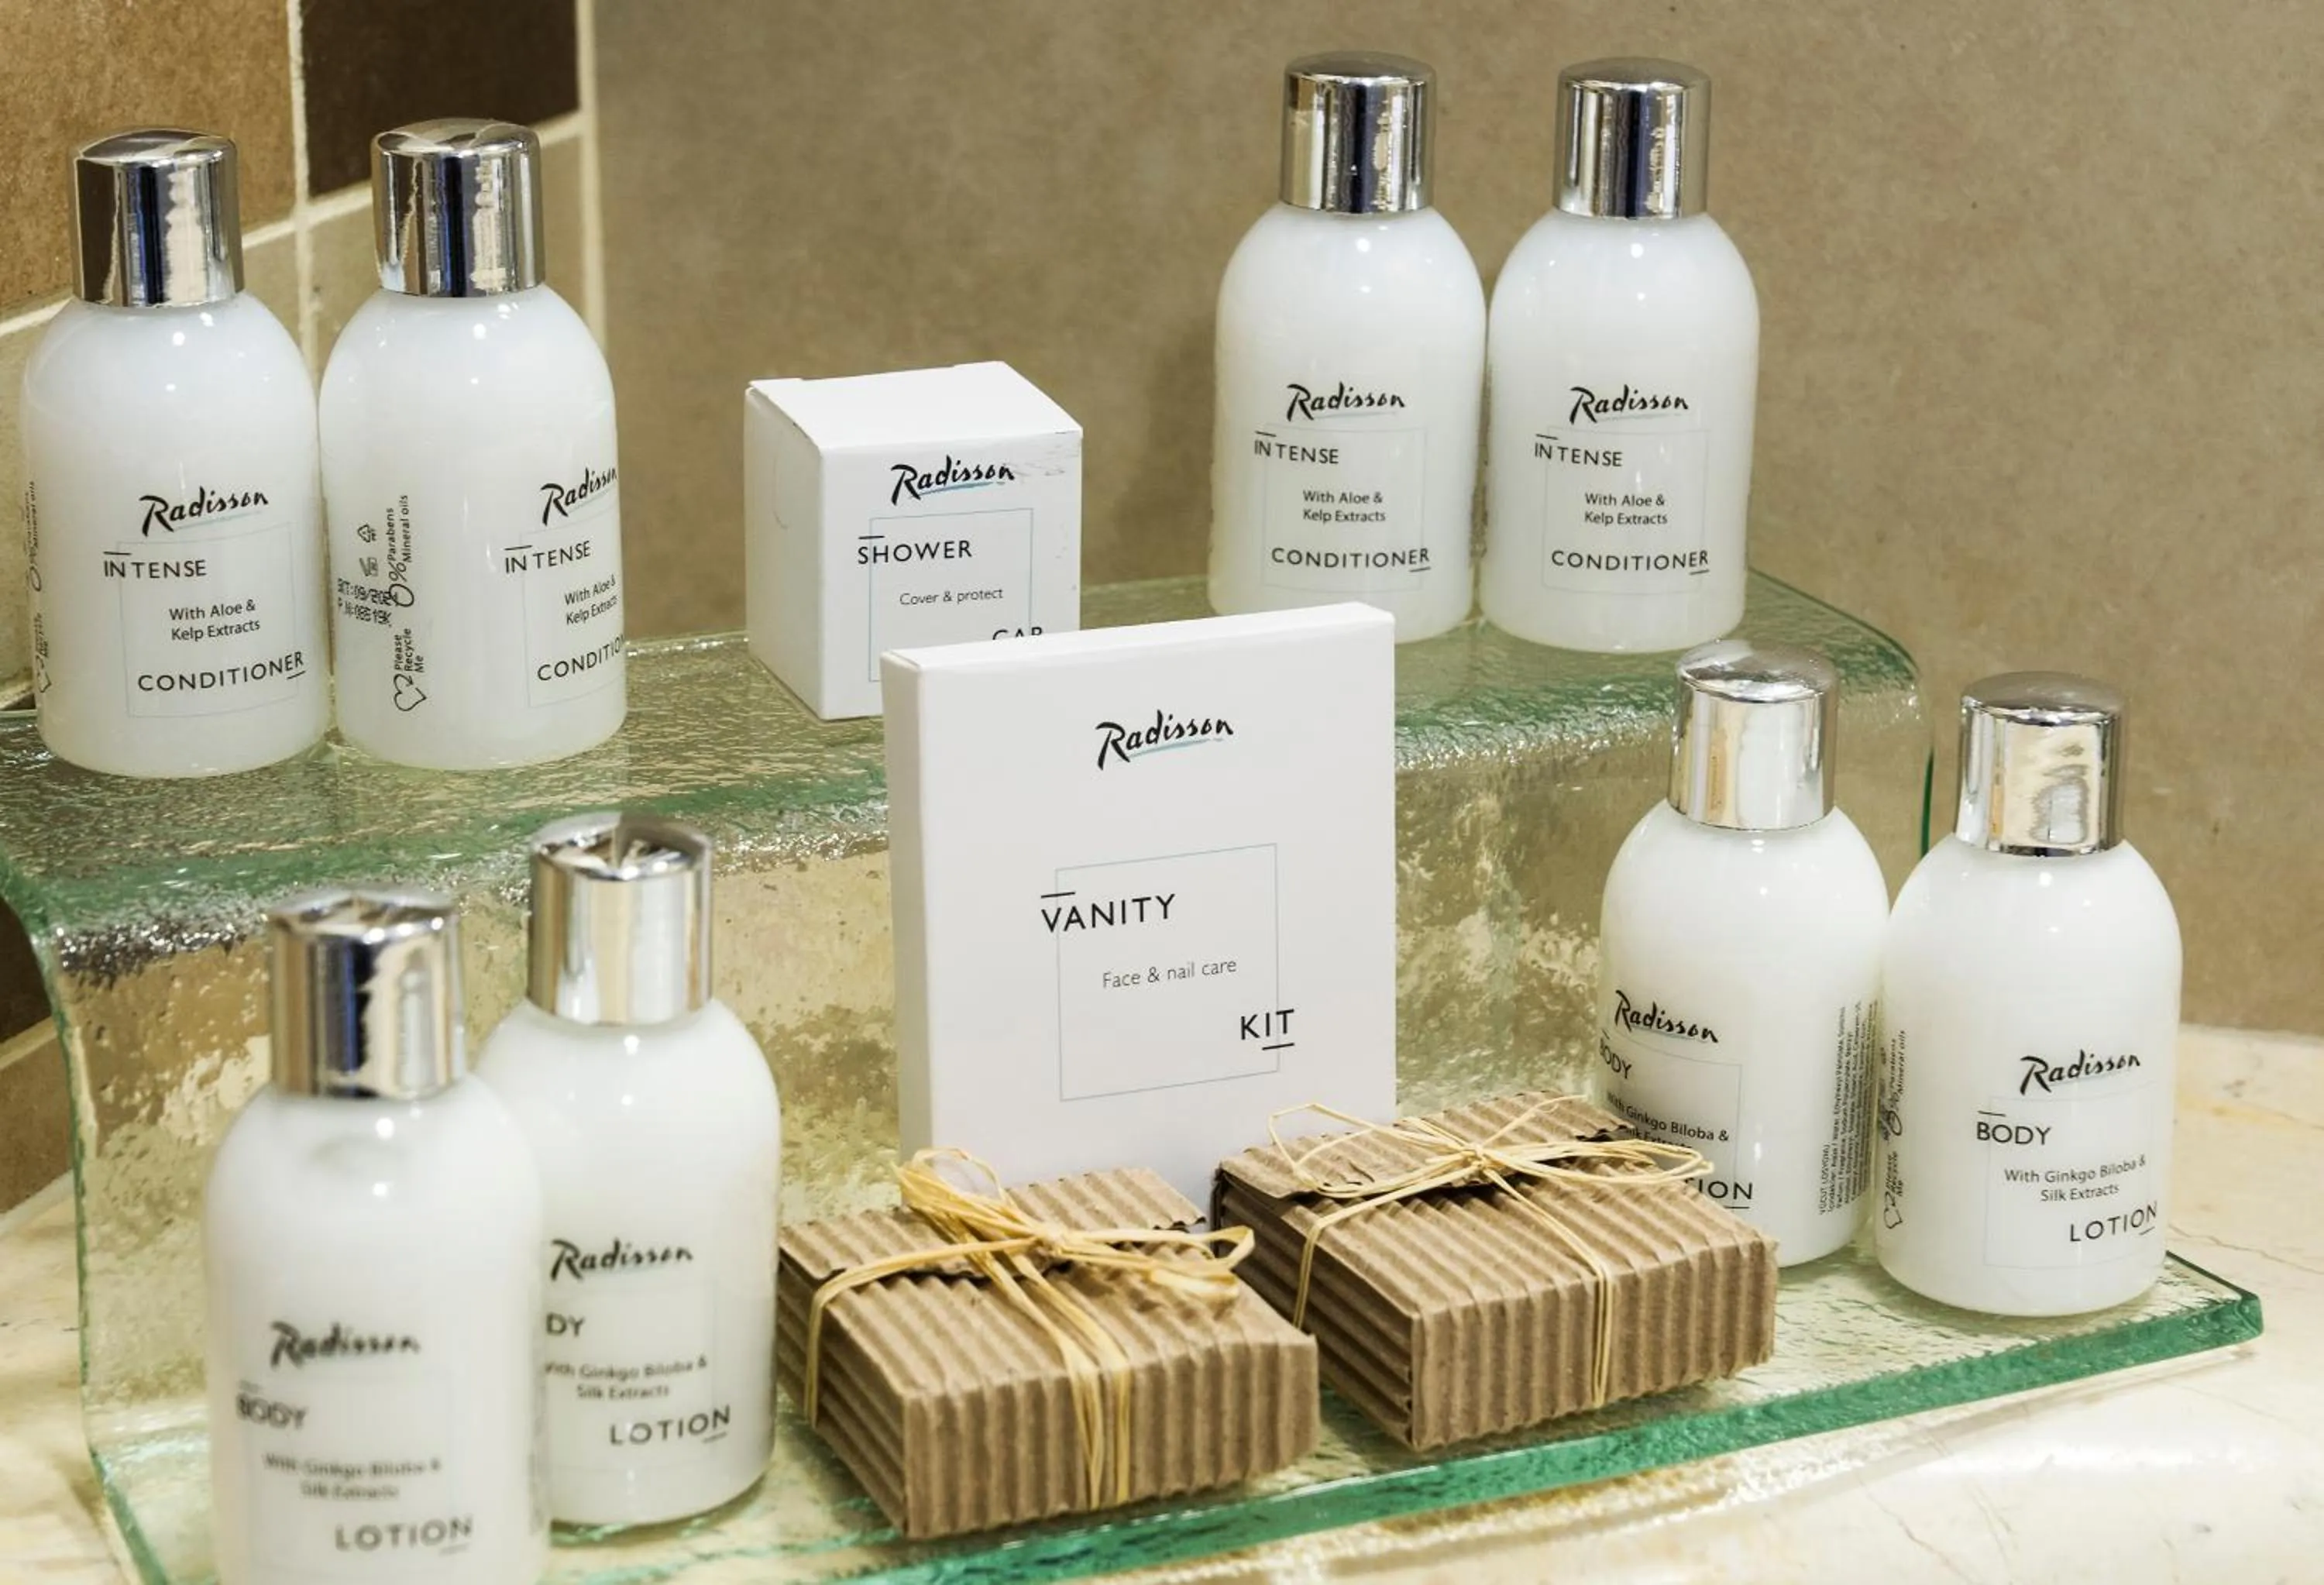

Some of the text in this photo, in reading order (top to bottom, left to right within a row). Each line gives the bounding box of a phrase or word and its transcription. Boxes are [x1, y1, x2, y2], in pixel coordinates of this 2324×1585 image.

[1286, 381, 1406, 421] Radisson
[1569, 384, 1689, 425] Radisson
[1254, 440, 1339, 464] INTENSE
[1535, 442, 1622, 466] INTENSE
[891, 455, 1015, 505] Radisson
[139, 487, 269, 537] Radisson
[399, 494, 408, 514] oils
[1303, 490, 1383, 504] With Aloe &
[1585, 493, 1666, 507] With Aloe &
[1303, 509, 1386, 524] Kelp Extracts
[1584, 511, 1668, 526] Kelp Extracts
[387, 508, 397, 561] Parabens
[401, 519, 411, 562] Mineral
[505, 540, 591, 573] INTENSE
[858, 541, 972, 564] SHOWER
[1272, 548, 1430, 569] CONDITIONER
[1552, 550, 1708, 571] CONDITIONER
[104, 559, 207, 579] INTENSE
[565, 587, 590, 606] With
[593, 579, 610, 595] Aloe
[900, 589, 1003, 606] Cover & protect
[170, 599, 256, 621] With Aloe &
[566, 607, 590, 626] Kelp
[171, 619, 261, 643] Kelp Extracts
[394, 635, 402, 670] Please
[404, 628, 414, 672] Recycle
[414, 655, 425, 672] Me
[538, 633, 625, 682] CONDITIO
[138, 652, 304, 691] CONDITIONER
[1095, 709, 1234, 771] Radisson
[1040, 894, 1175, 933] VANITY
[1103, 958, 1237, 988] Face & nail care
[1240, 1009, 1294, 1040] KIT
[1614, 989, 1719, 1043] Radisson
[2020, 1050, 2140, 1095] Radisson
[1627, 1105, 1667, 1131] Ginkgo
[1671, 1121, 1714, 1142] Biloba
[1718, 1129, 1730, 1142] &
[1976, 1122, 2051, 1145] BODY
[2005, 1168, 2040, 1184] With
[2044, 1168, 2096, 1184] Ginkgo
[2100, 1160, 2137, 1178] Biloba
[2040, 1184, 2119, 1202] Silk Extracts
[2070, 1202, 2157, 1242] LOTION
[550, 1237, 693, 1281] Radisson
[546, 1312, 585, 1336] DY
[269, 1320, 421, 1370] Radisson
[610, 1404, 731, 1446] LOTION
[335, 1515, 473, 1551] LOTION
